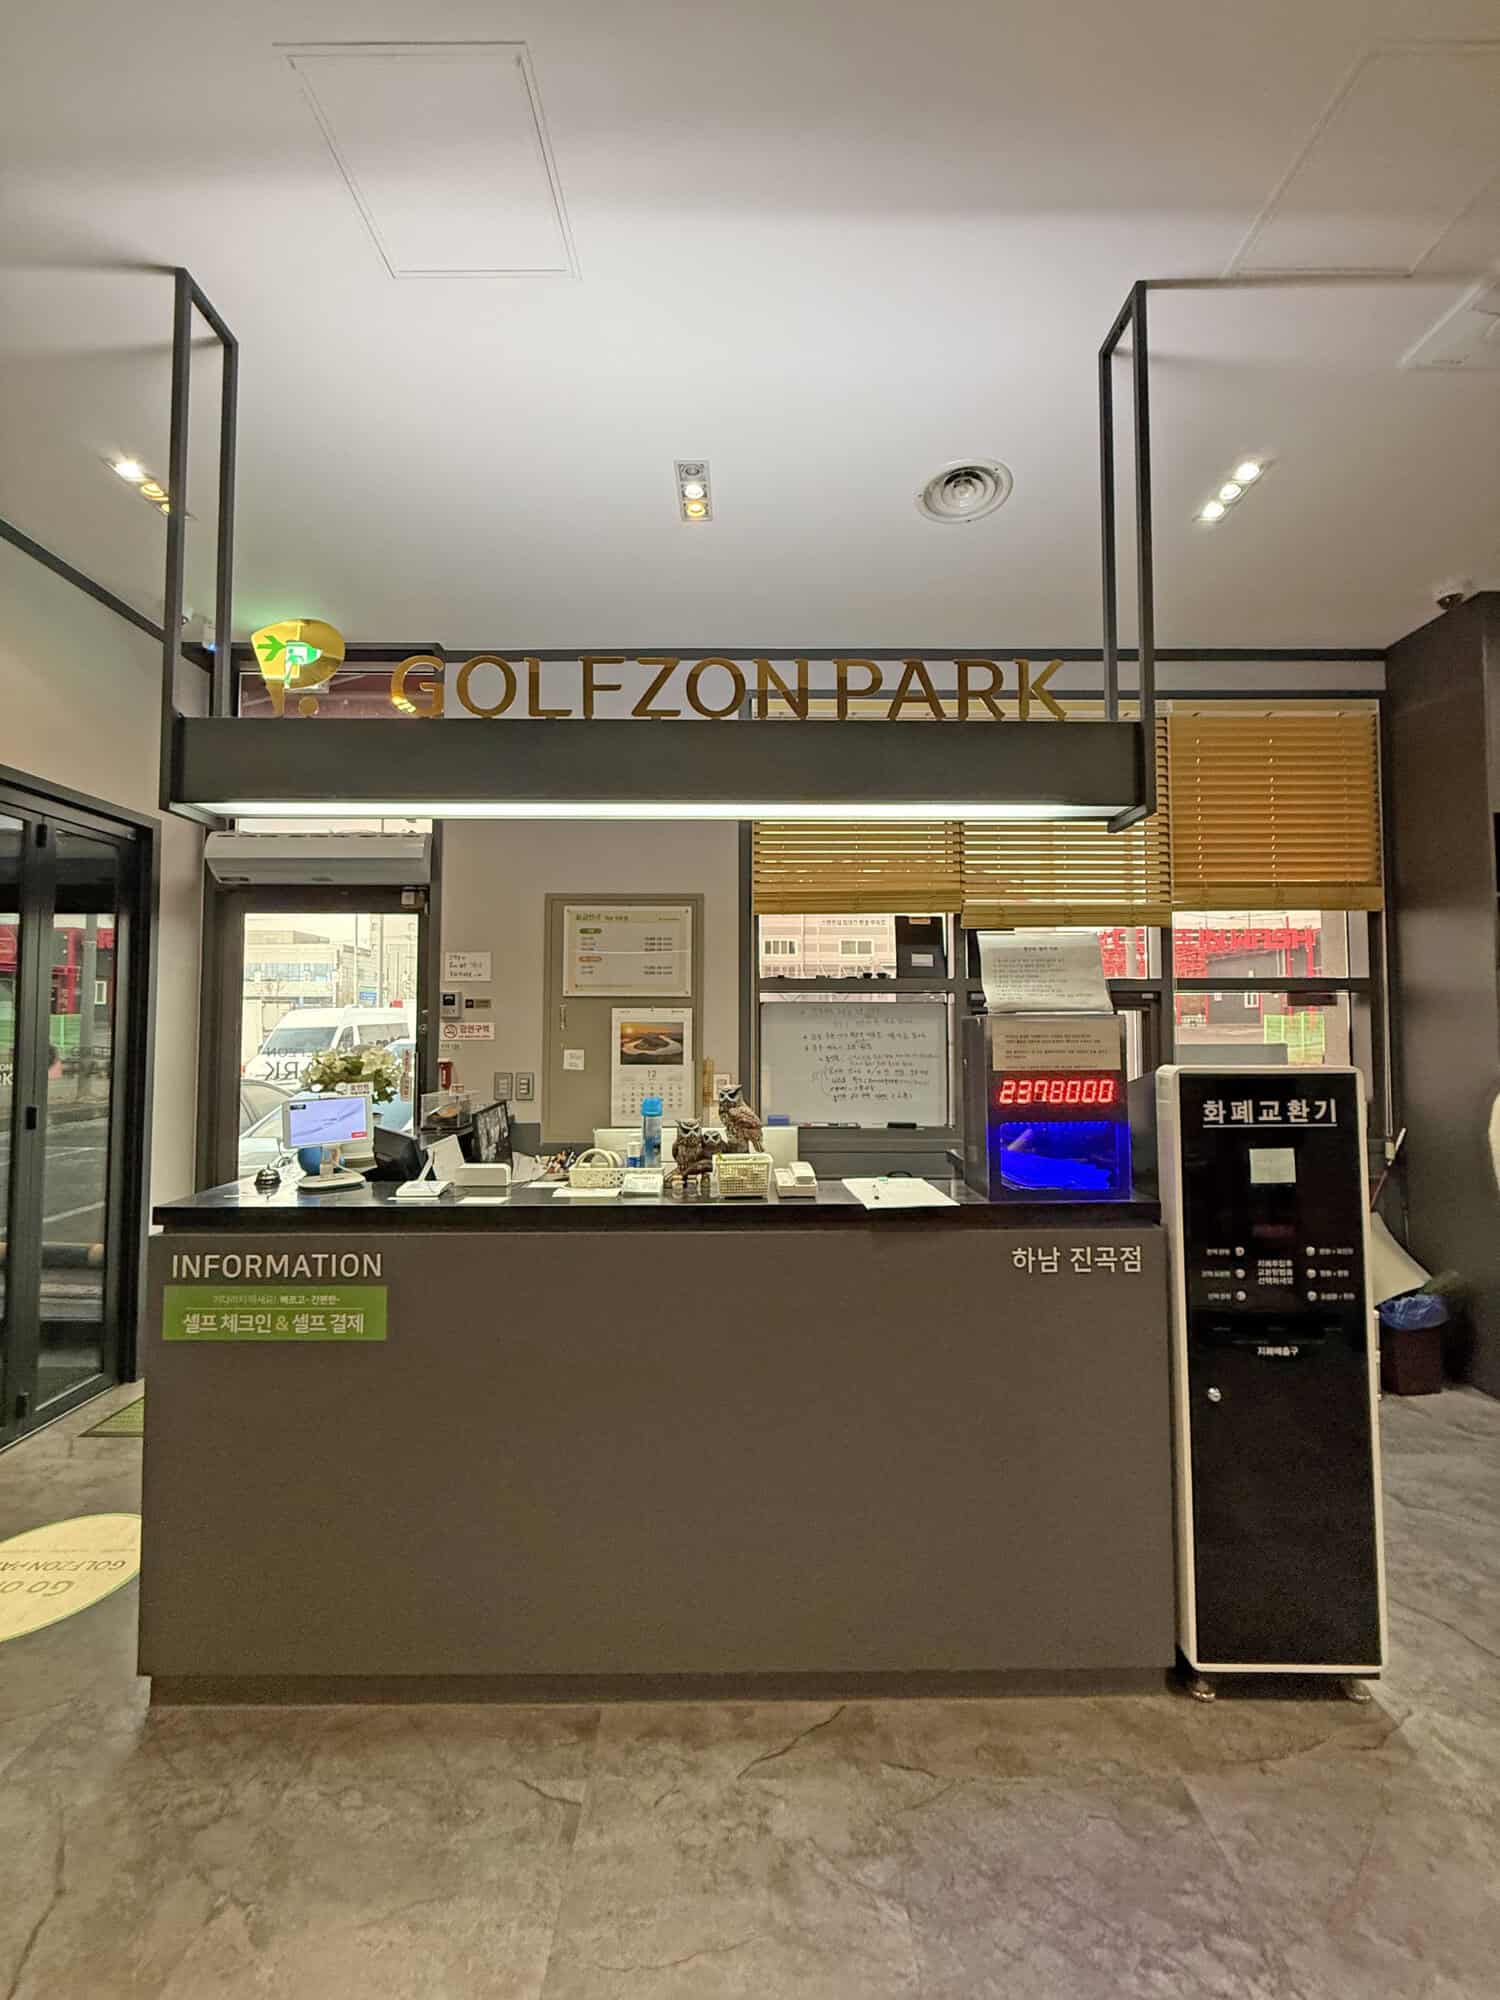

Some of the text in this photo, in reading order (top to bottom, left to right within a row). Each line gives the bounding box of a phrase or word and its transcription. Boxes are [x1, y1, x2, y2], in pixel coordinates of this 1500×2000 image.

[832, 658, 1067, 720] PARK
[1203, 1098, 1337, 1124] 화폐교환기
[172, 1253, 383, 1278] INFORMATION
[1011, 1245, 1142, 1273] 하남 진곡점
[182, 1313, 365, 1334] 셀프 체크인 & 셀프 결제
